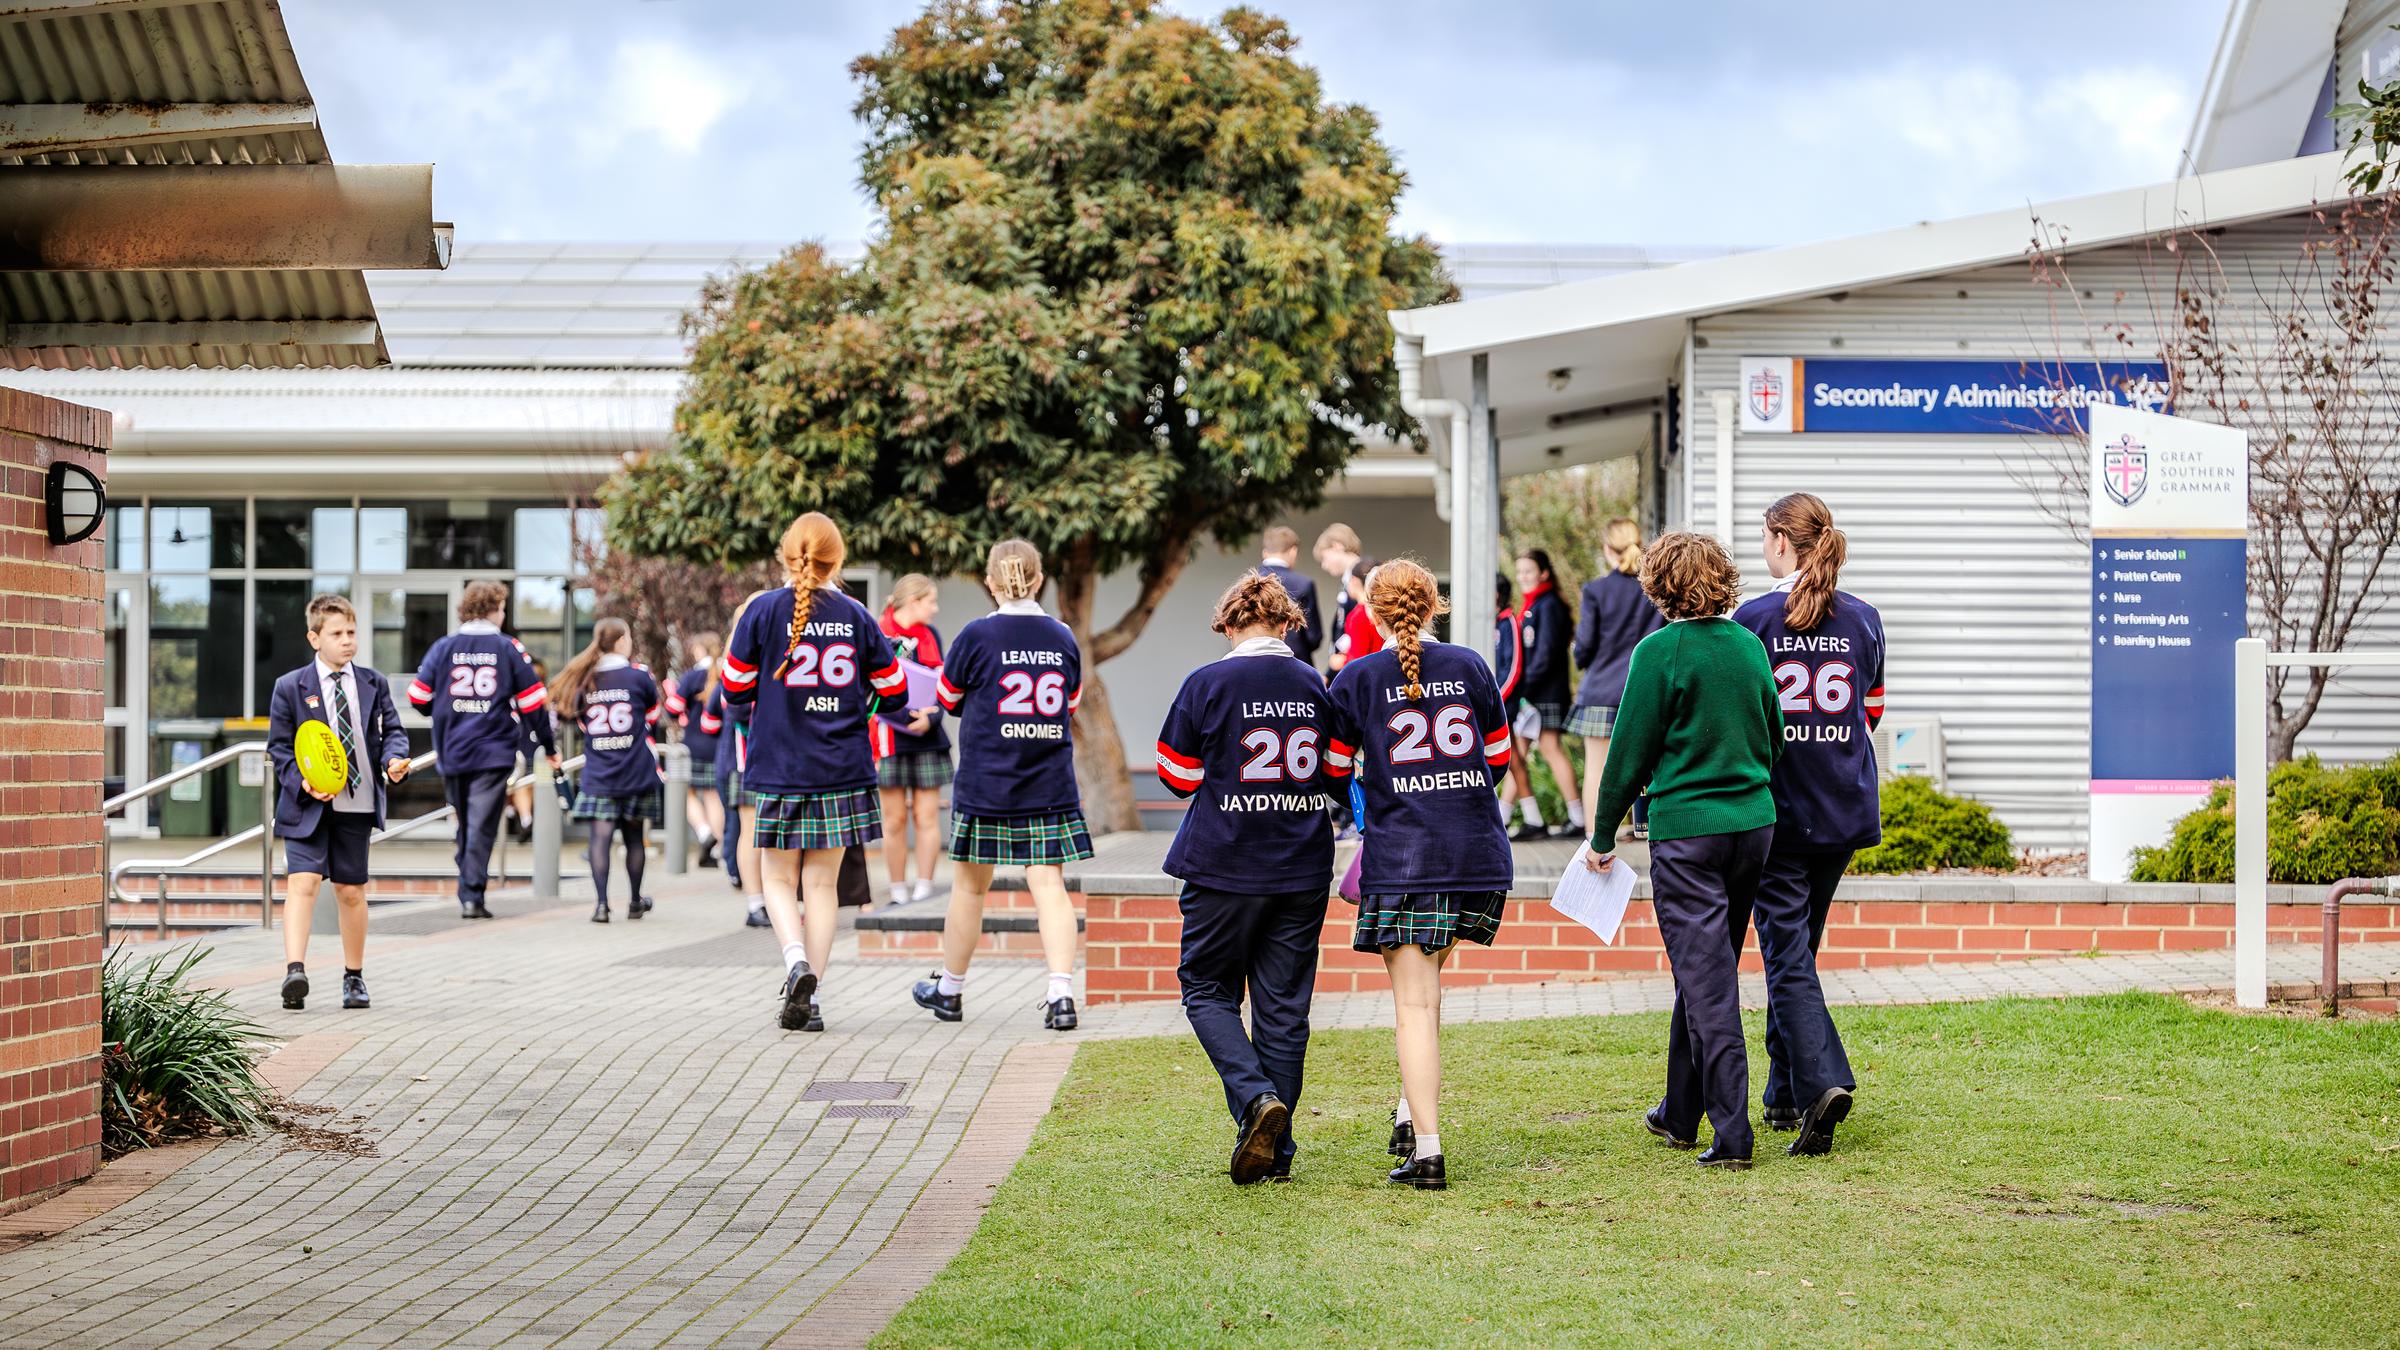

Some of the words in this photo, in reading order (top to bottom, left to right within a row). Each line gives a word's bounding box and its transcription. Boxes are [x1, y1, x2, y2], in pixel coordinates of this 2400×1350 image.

[1814, 383, 1938, 411] Secondary
[1944, 383, 2116, 409] Administration
[2161, 452, 2203, 462] GREAT
[2161, 467, 2235, 477] SOUTHERN
[2161, 482, 2232, 492] GRAMMAR
[2114, 549, 2144, 560] Senior
[2145, 549, 2177, 560] School
[2114, 571, 2148, 582] Pratten
[2150, 571, 2182, 582] Centre
[2114, 592, 2141, 603] Nurse
[2114, 613, 2166, 627] Performing
[2168, 614, 2189, 625] Arts
[787, 622, 854, 637] LAVERS
[1773, 636, 1850, 653] LEAVERS
[2114, 635, 2155, 648] Boarding
[2157, 635, 2191, 646] Houses
[784, 642, 857, 688] 26
[1001, 650, 1063, 666] LEAVERS
[450, 665, 498, 697] 26
[1773, 660, 1854, 714] 26
[998, 670, 1066, 717] 26
[1386, 681, 1466, 703] LEVERS
[805, 696, 839, 712] ASH
[1242, 702, 1315, 719] LEAVERS
[586, 702, 634, 735] 26
[1000, 723, 1063, 739] GNOMES
[1387, 704, 1476, 765] 26
[1784, 725, 1810, 742] OU
[1816, 725, 1851, 742] LOU
[320, 732, 343, 775] Burley
[1240, 727, 1320, 782] 26
[1392, 770, 1487, 793] MADEENA
